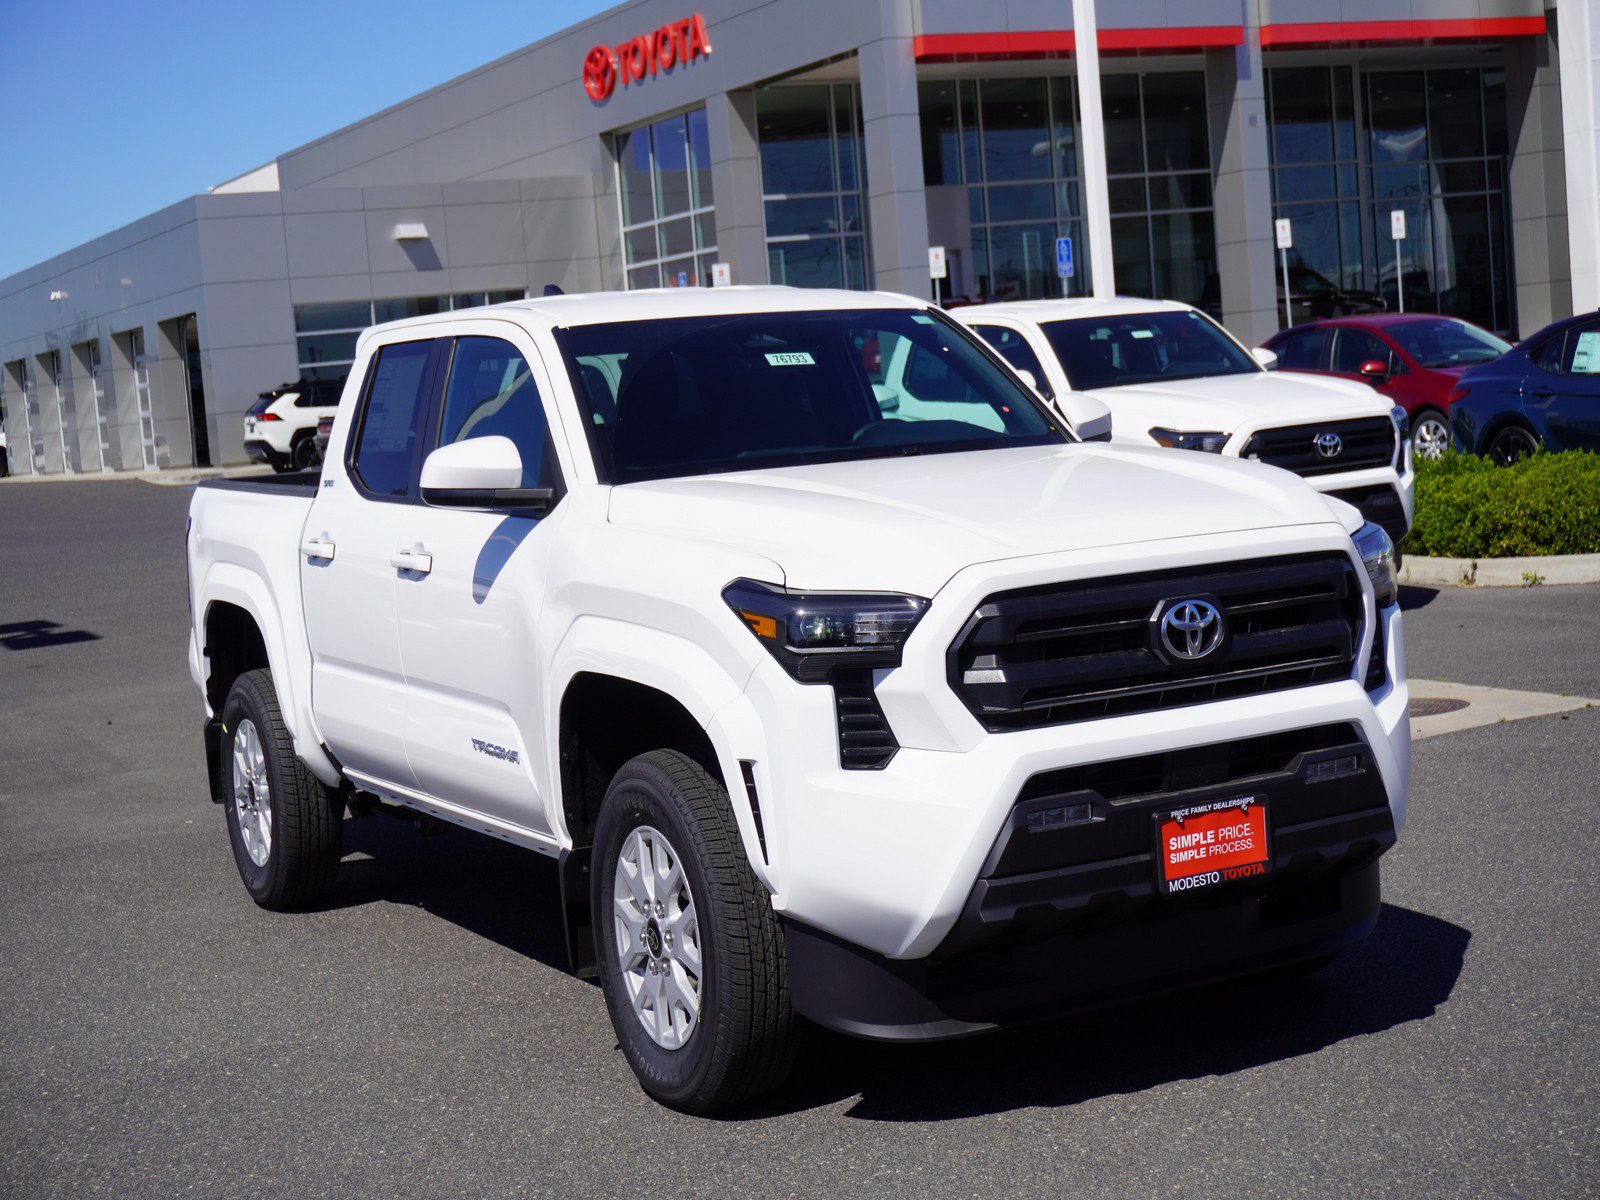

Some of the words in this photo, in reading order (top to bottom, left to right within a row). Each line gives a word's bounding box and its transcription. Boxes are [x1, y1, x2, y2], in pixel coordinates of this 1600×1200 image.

[614, 13, 712, 85] TOYOTA
[772, 354, 808, 364] 76793
[1170, 809, 1189, 818] PRICE
[1190, 804, 1212, 814] FAMILY
[1213, 797, 1255, 810] DEALERSHIPS
[1169, 830, 1215, 850] SIMPLE
[1218, 823, 1254, 841] PRICE.
[1170, 847, 1207, 864] SIMPLE
[1209, 838, 1255, 856] PROCESS.
[1169, 871, 1220, 893] MODESTO
[1222, 863, 1265, 881] TOYOTA
